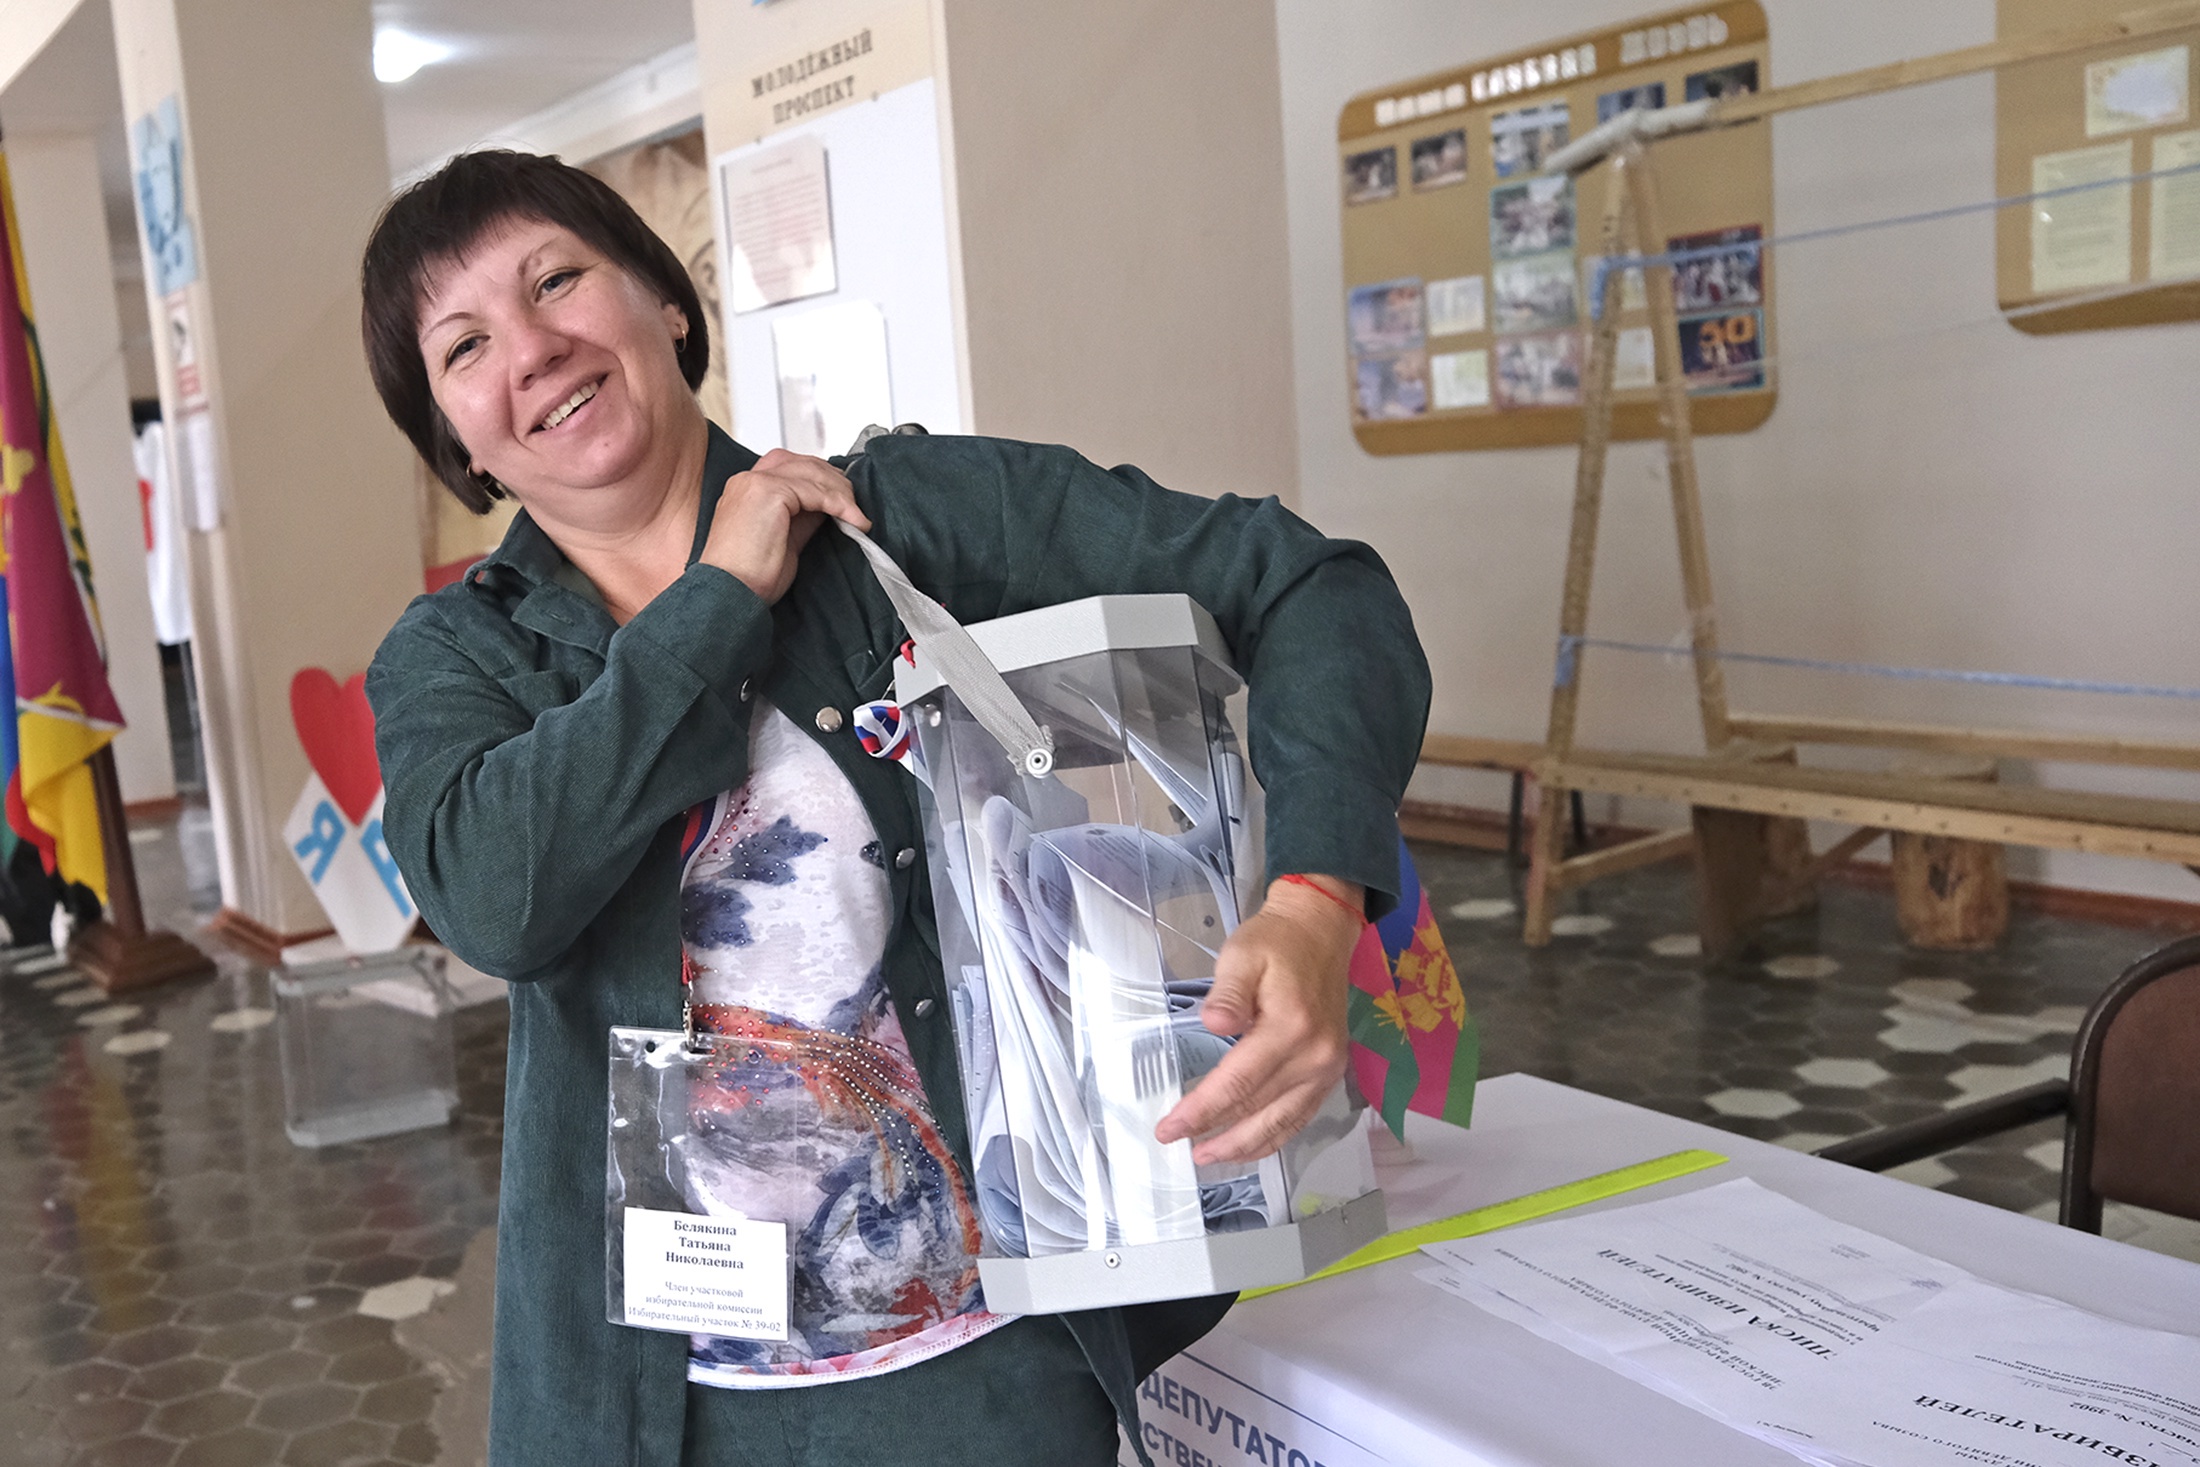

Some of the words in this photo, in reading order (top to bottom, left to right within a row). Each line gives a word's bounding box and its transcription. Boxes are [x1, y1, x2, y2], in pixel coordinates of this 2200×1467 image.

[751, 27, 873, 98] МОЛОДЁЖНЫЙ
[773, 74, 855, 124] ПРОСПЕКТ
[294, 799, 346, 885] Я
[674, 1220, 737, 1236] Белякина
[678, 1236, 731, 1251] Татьяна
[666, 1251, 744, 1269] Николаевна
[665, 1281, 688, 1292] Член
[690, 1286, 744, 1298] участковой
[1596, 1247, 1747, 1316] ИЗБИРАТЕЛЕЙ
[645, 1295, 714, 1310] избирательной
[717, 1304, 763, 1315] комиссии
[629, 1306, 700, 1323] Избирательный
[702, 1317, 739, 1327] участок
[741, 1320, 752, 1329] №
[755, 1321, 781, 1332] 39-02
[1141, 1370, 1328, 1467] ДЕПУТАТО
[2069, 1401, 2110, 1416] 3902
[2112, 1412, 2133, 1422] №
[1872, 1420, 1928, 1440] СОЗЫВА
[1931, 1437, 2011, 1461] ДЕВЯТОГО
[1954, 1450, 2002, 1466] ДУМЫ
